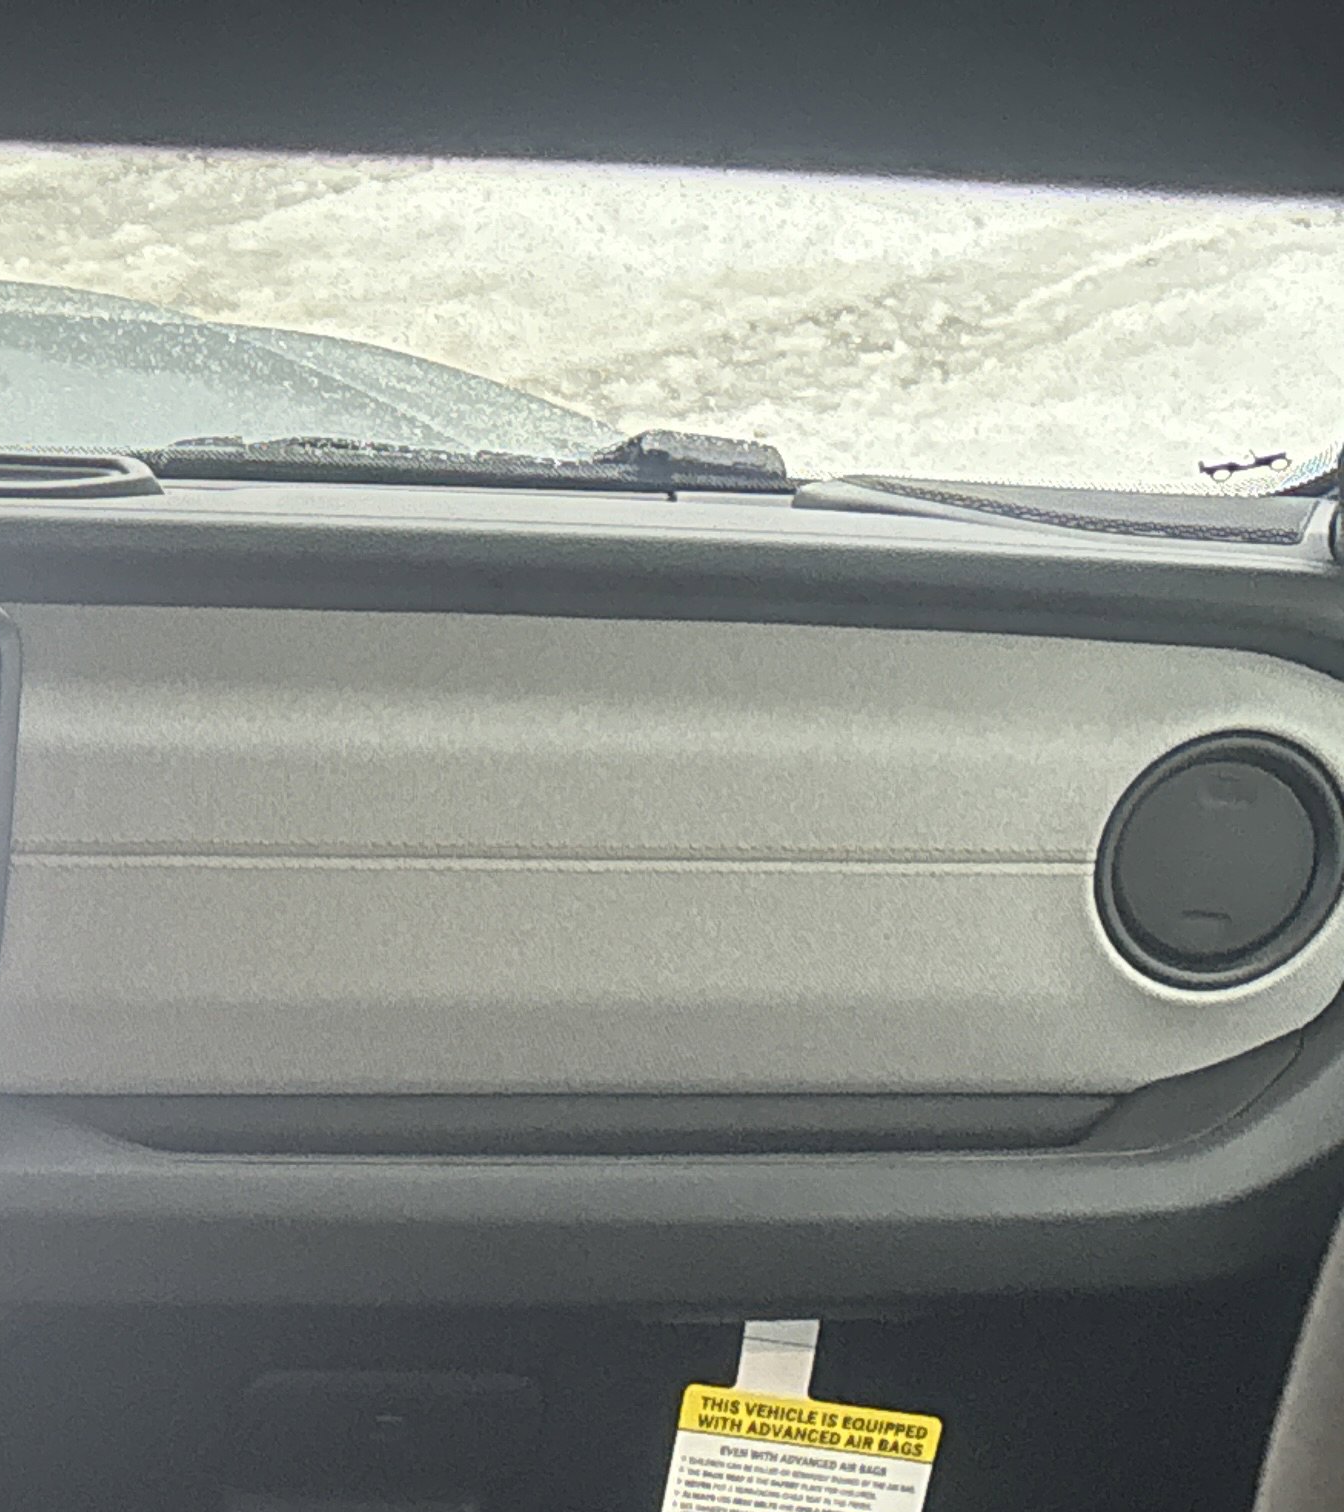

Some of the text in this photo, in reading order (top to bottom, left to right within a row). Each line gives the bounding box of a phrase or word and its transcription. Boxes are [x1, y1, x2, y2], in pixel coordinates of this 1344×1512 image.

[698, 1413, 924, 1457] WITH ADVANCED AIR BAGS
[701, 1396, 928, 1440] THIS VEHICLE IS EQUIPPED
[780, 1454, 838, 1470] ADVANCED
